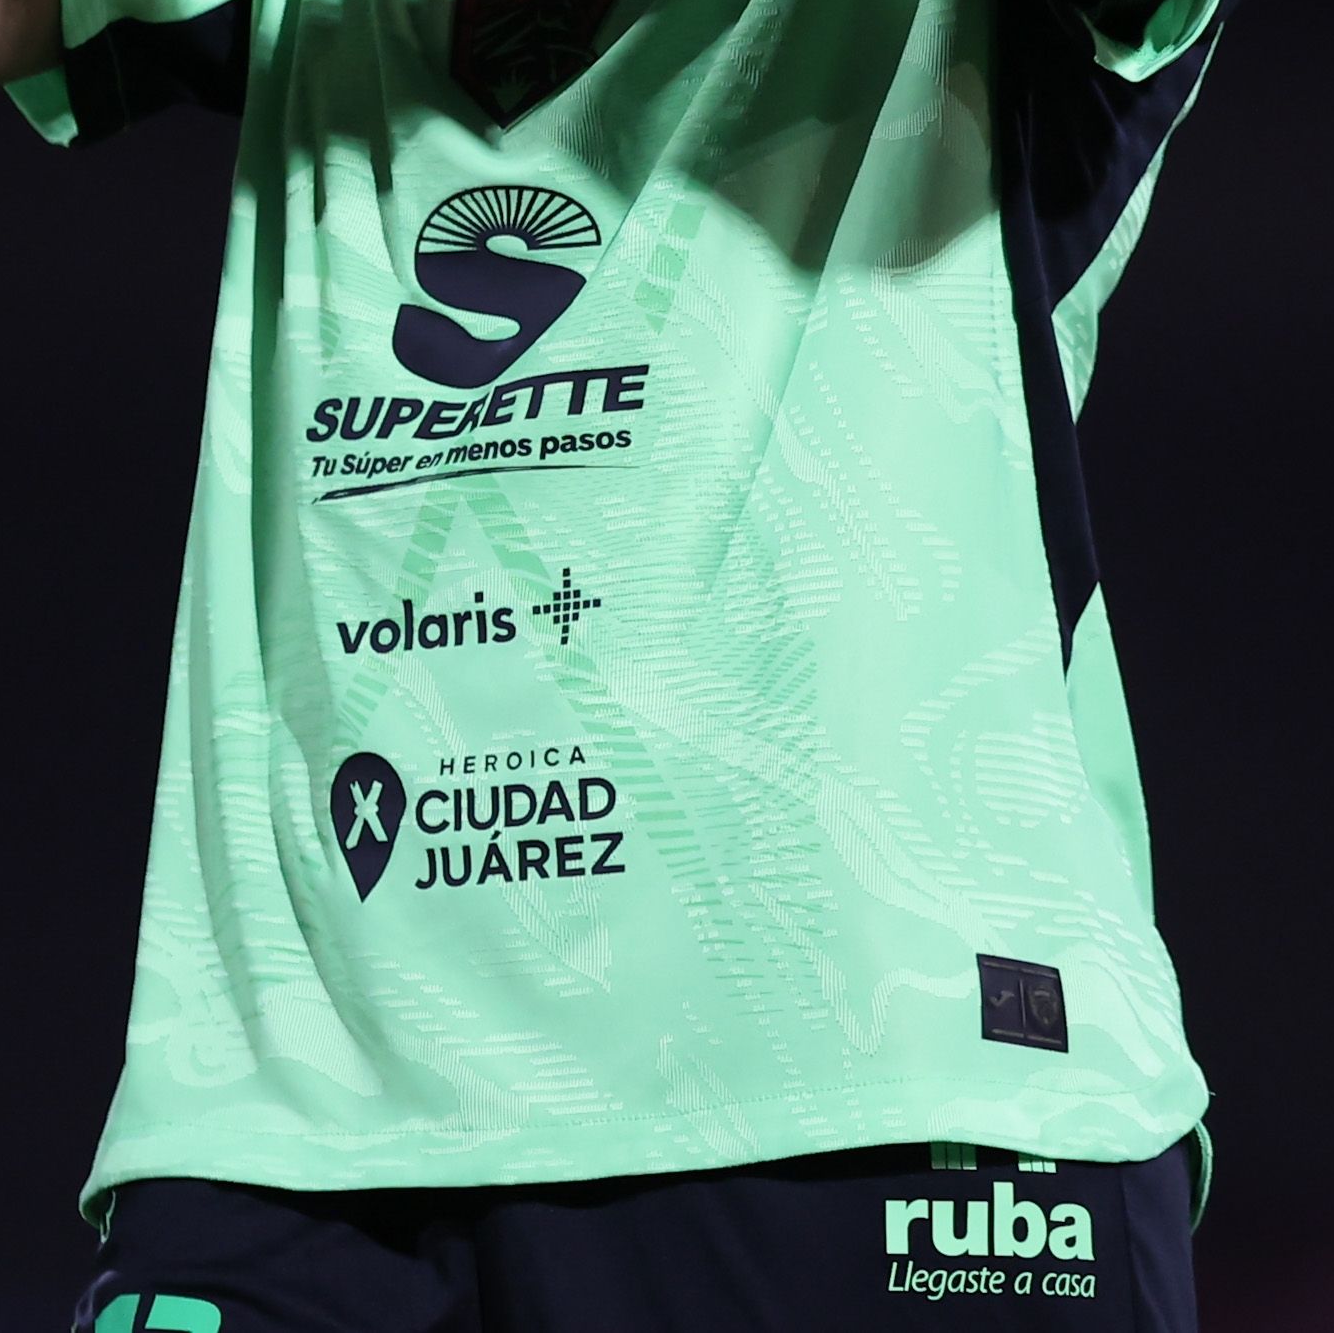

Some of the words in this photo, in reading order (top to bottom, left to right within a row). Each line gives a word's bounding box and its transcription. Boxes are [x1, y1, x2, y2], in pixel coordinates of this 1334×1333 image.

[305, 364, 650, 443] SUPERETTE
[311, 455, 338, 478] Tu
[340, 451, 414, 480] Súper
[414, 451, 444, 470] en
[444, 437, 533, 466] menos
[539, 429, 632, 460] pasos
[336, 591, 518, 654] volaris
[439, 746, 586, 777] HEROICA
[414, 777, 617, 835] CIUDAD
[414, 830, 626, 890] JUÁREZ
[884, 1180, 1096, 1261] ruba
[887, 1260, 1006, 1301] Llegaste
[1013, 1271, 1033, 1295] a
[1041, 1270, 1096, 1298] casa
